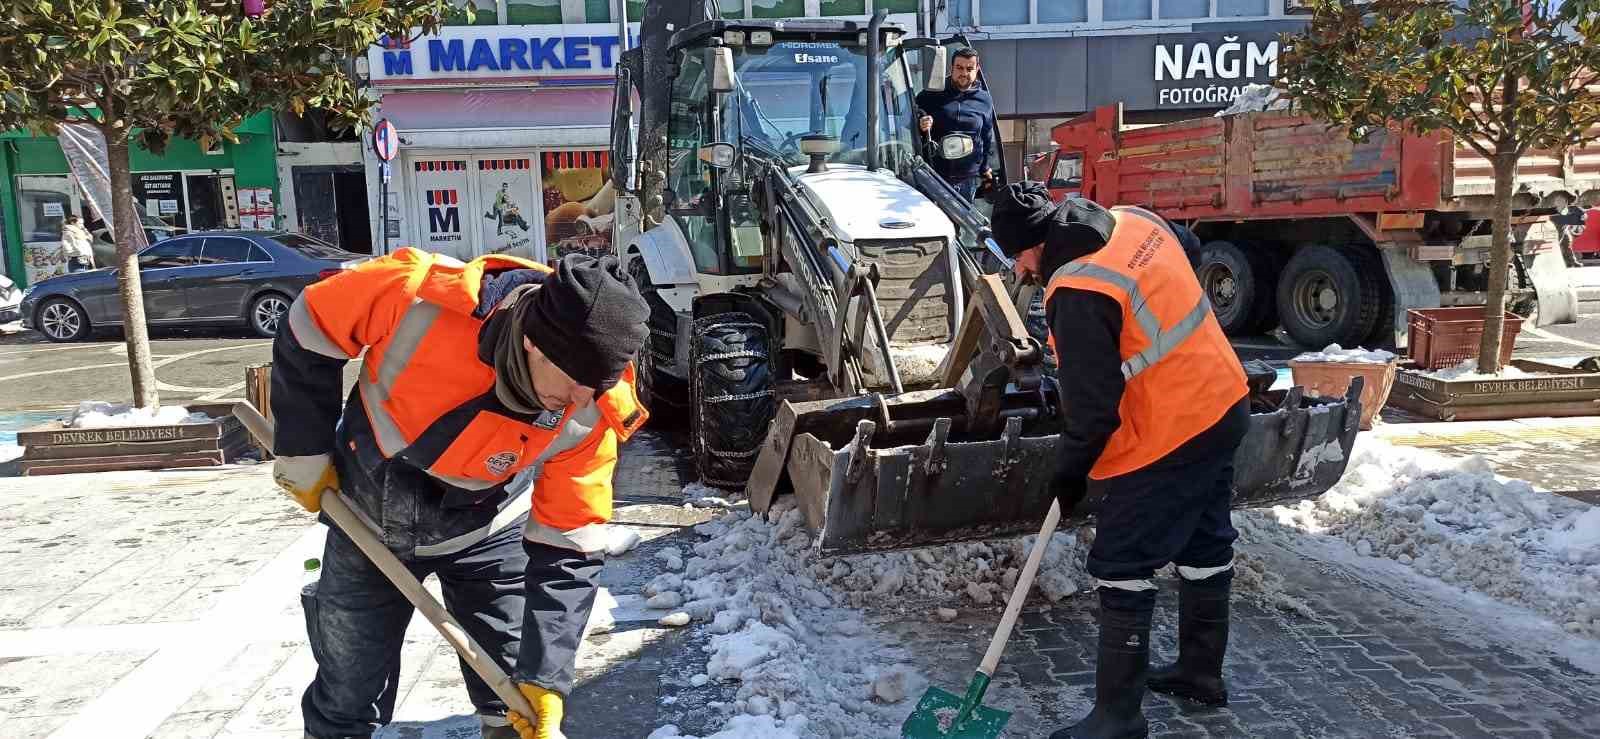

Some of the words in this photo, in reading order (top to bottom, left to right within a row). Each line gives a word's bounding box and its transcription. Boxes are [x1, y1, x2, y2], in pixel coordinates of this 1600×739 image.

[795, 53, 838, 63] Efsane
[1154, 36, 1293, 81] NAĞM
[428, 207, 460, 233] M
[53, 431, 102, 444] DEVREK
